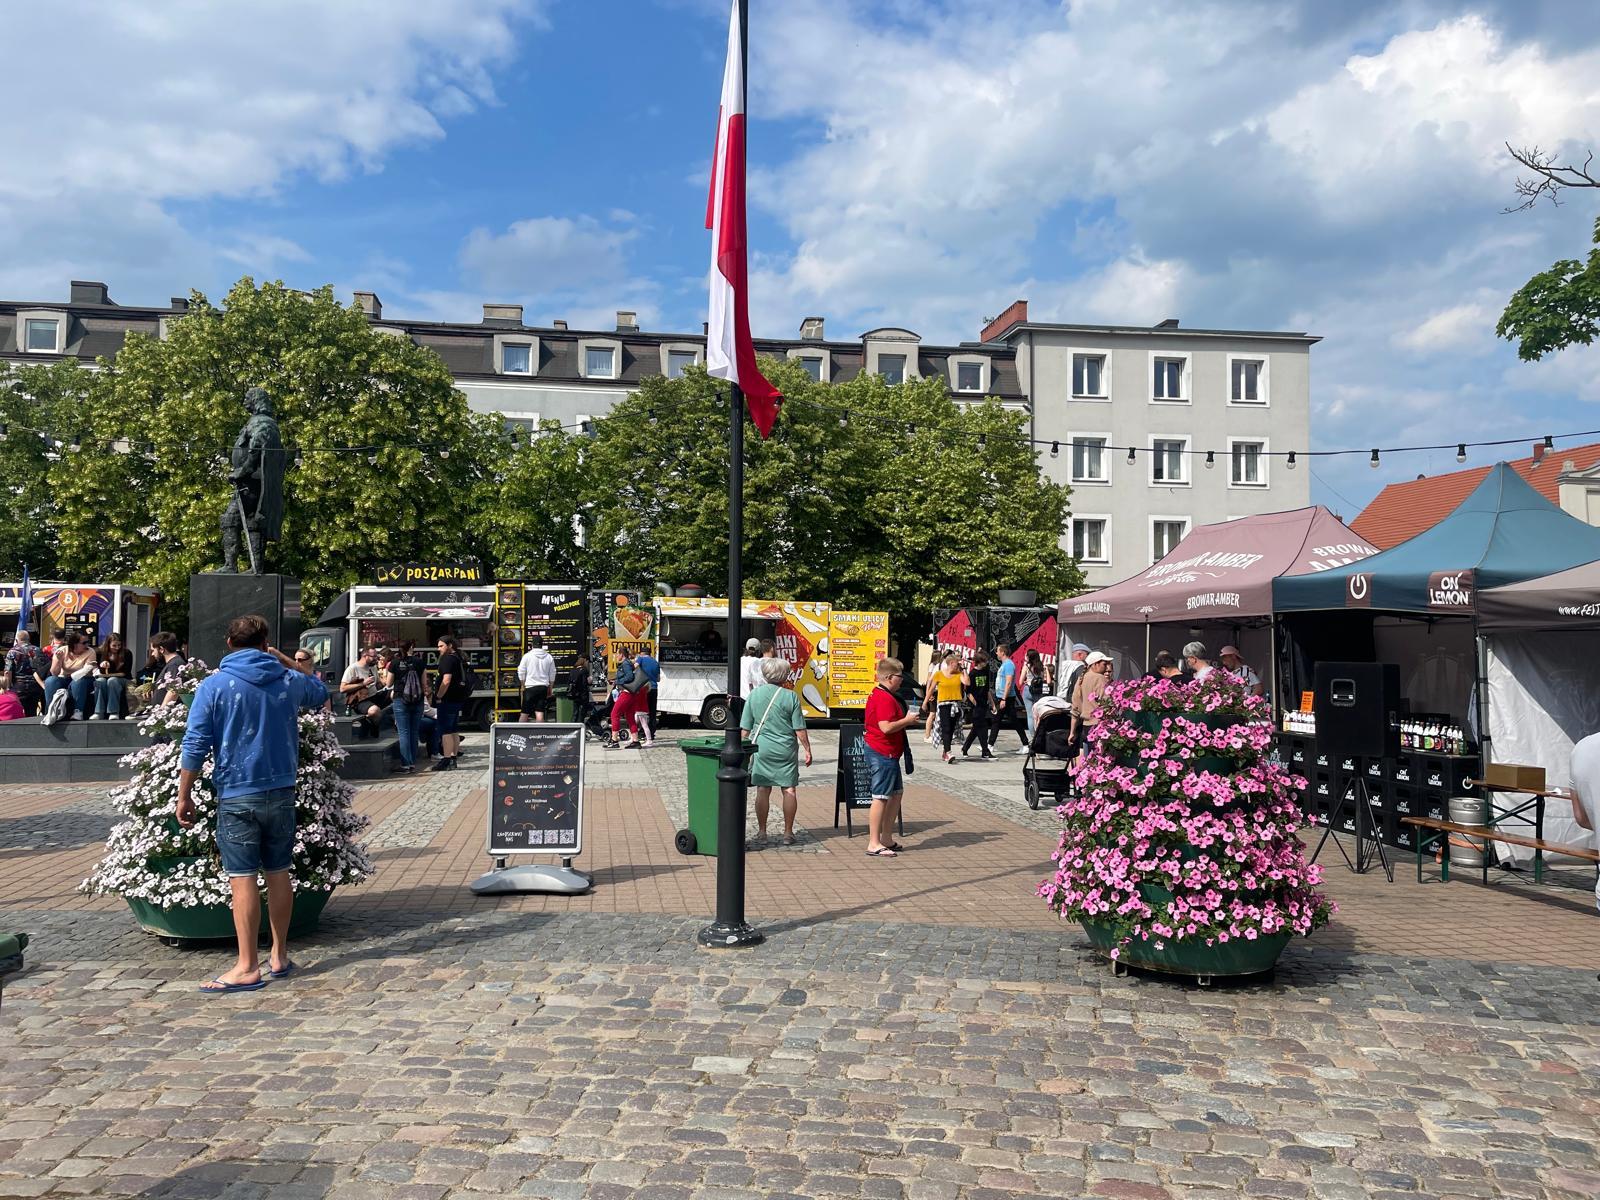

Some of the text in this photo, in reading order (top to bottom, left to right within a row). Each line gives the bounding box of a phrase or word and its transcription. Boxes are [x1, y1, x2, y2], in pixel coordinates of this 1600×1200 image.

[1201, 552, 1263, 569] AMBER
[541, 594, 565, 605] MENU
[1187, 593, 1240, 609] BROWAR AMBER
[1430, 589, 1470, 604] LEMON
[1074, 603, 1110, 615] BROWAR AMBER
[1559, 604, 1600, 616] www.FEST
[834, 614, 860, 622] SMAKI
[776, 634, 797, 648] AKI
